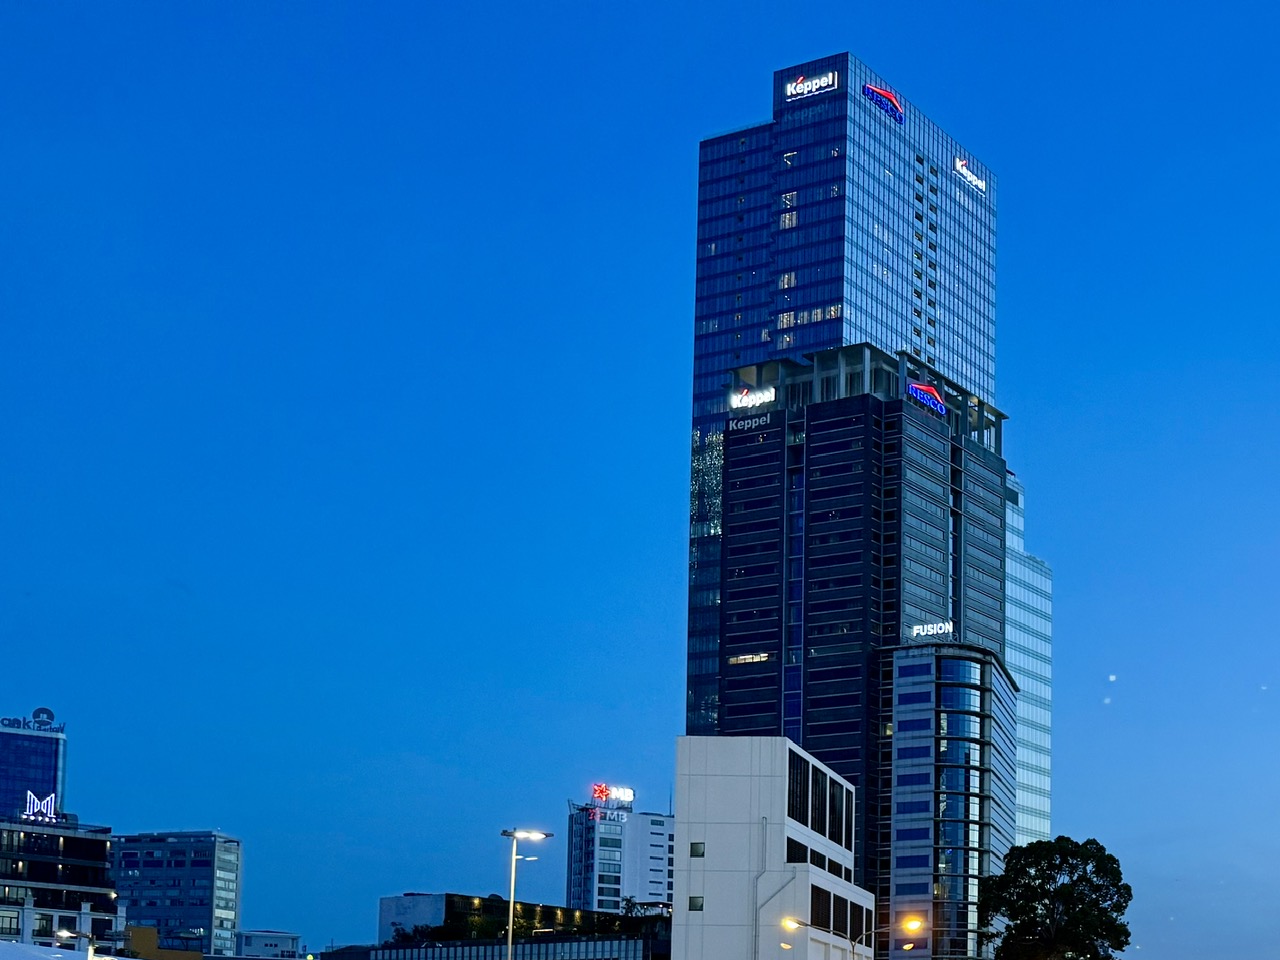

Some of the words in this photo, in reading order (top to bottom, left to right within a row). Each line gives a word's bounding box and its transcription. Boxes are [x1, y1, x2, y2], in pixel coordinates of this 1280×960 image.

[908, 383, 947, 416] RESCO
[913, 620, 953, 637] FUSION
[611, 787, 634, 802] MB
